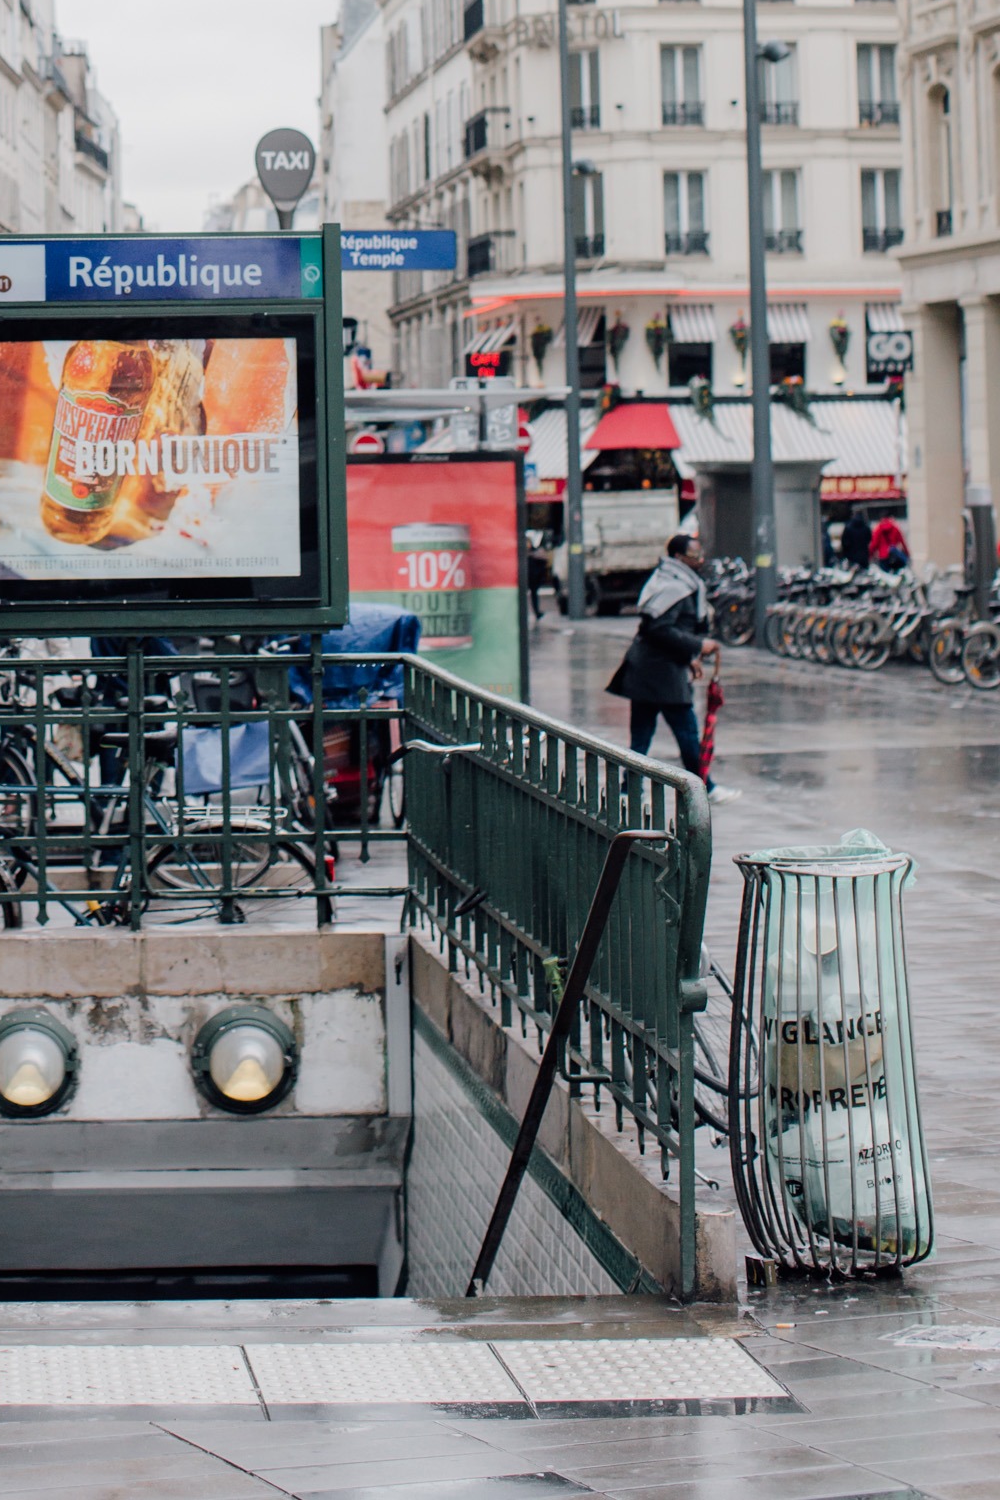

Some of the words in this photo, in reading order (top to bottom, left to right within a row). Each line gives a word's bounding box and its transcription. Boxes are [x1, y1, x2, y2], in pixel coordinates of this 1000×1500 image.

[260, 150, 310, 171] TAXI
[68, 254, 262, 296] République
[350, 251, 405, 267] Temple
[869, 333, 912, 360] GO
[75, 439, 159, 477] BORN
[170, 438, 280, 477] UNIQUE
[397, 551, 466, 589] -10%
